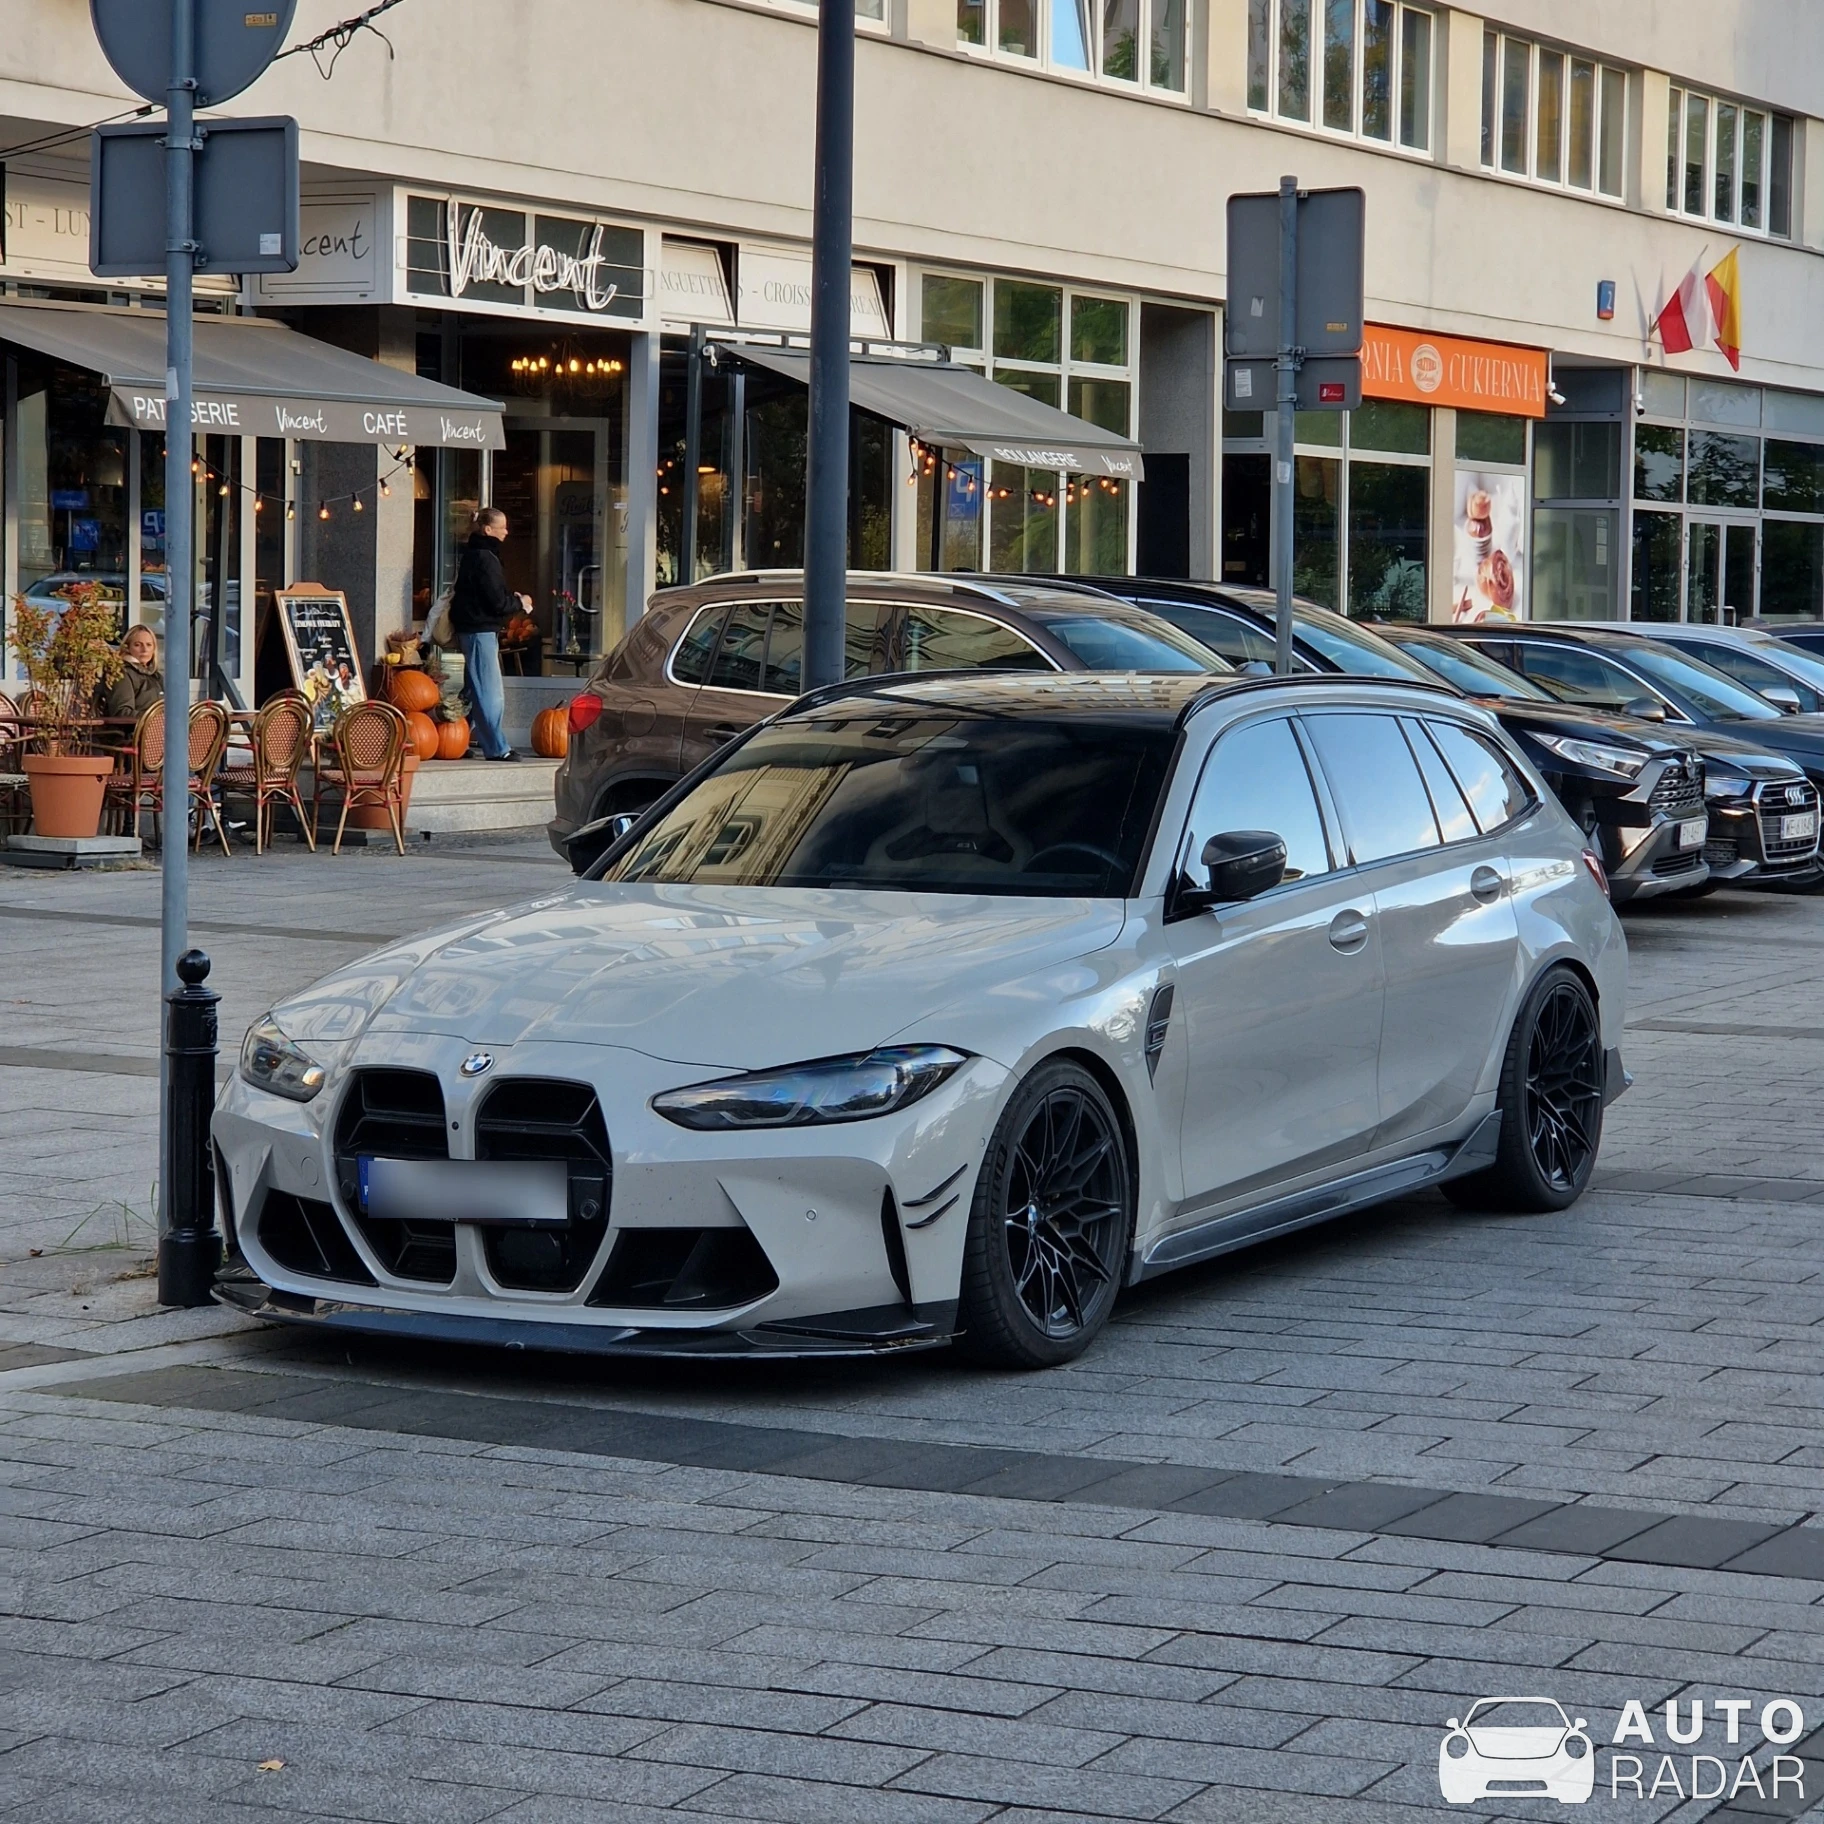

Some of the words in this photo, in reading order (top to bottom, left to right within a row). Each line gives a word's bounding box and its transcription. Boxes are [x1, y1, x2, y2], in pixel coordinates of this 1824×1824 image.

[299, 220, 370, 260] cent
[447, 197, 618, 310] Vincent
[763, 280, 812, 306] CROISS
[1449, 352, 1541, 403] CUKIERNIA
[133, 396, 241, 427] PATSERIE
[274, 405, 328, 434] Vincent
[363, 410, 408, 436] CAFÉ
[440, 416, 486, 443] Vincent
